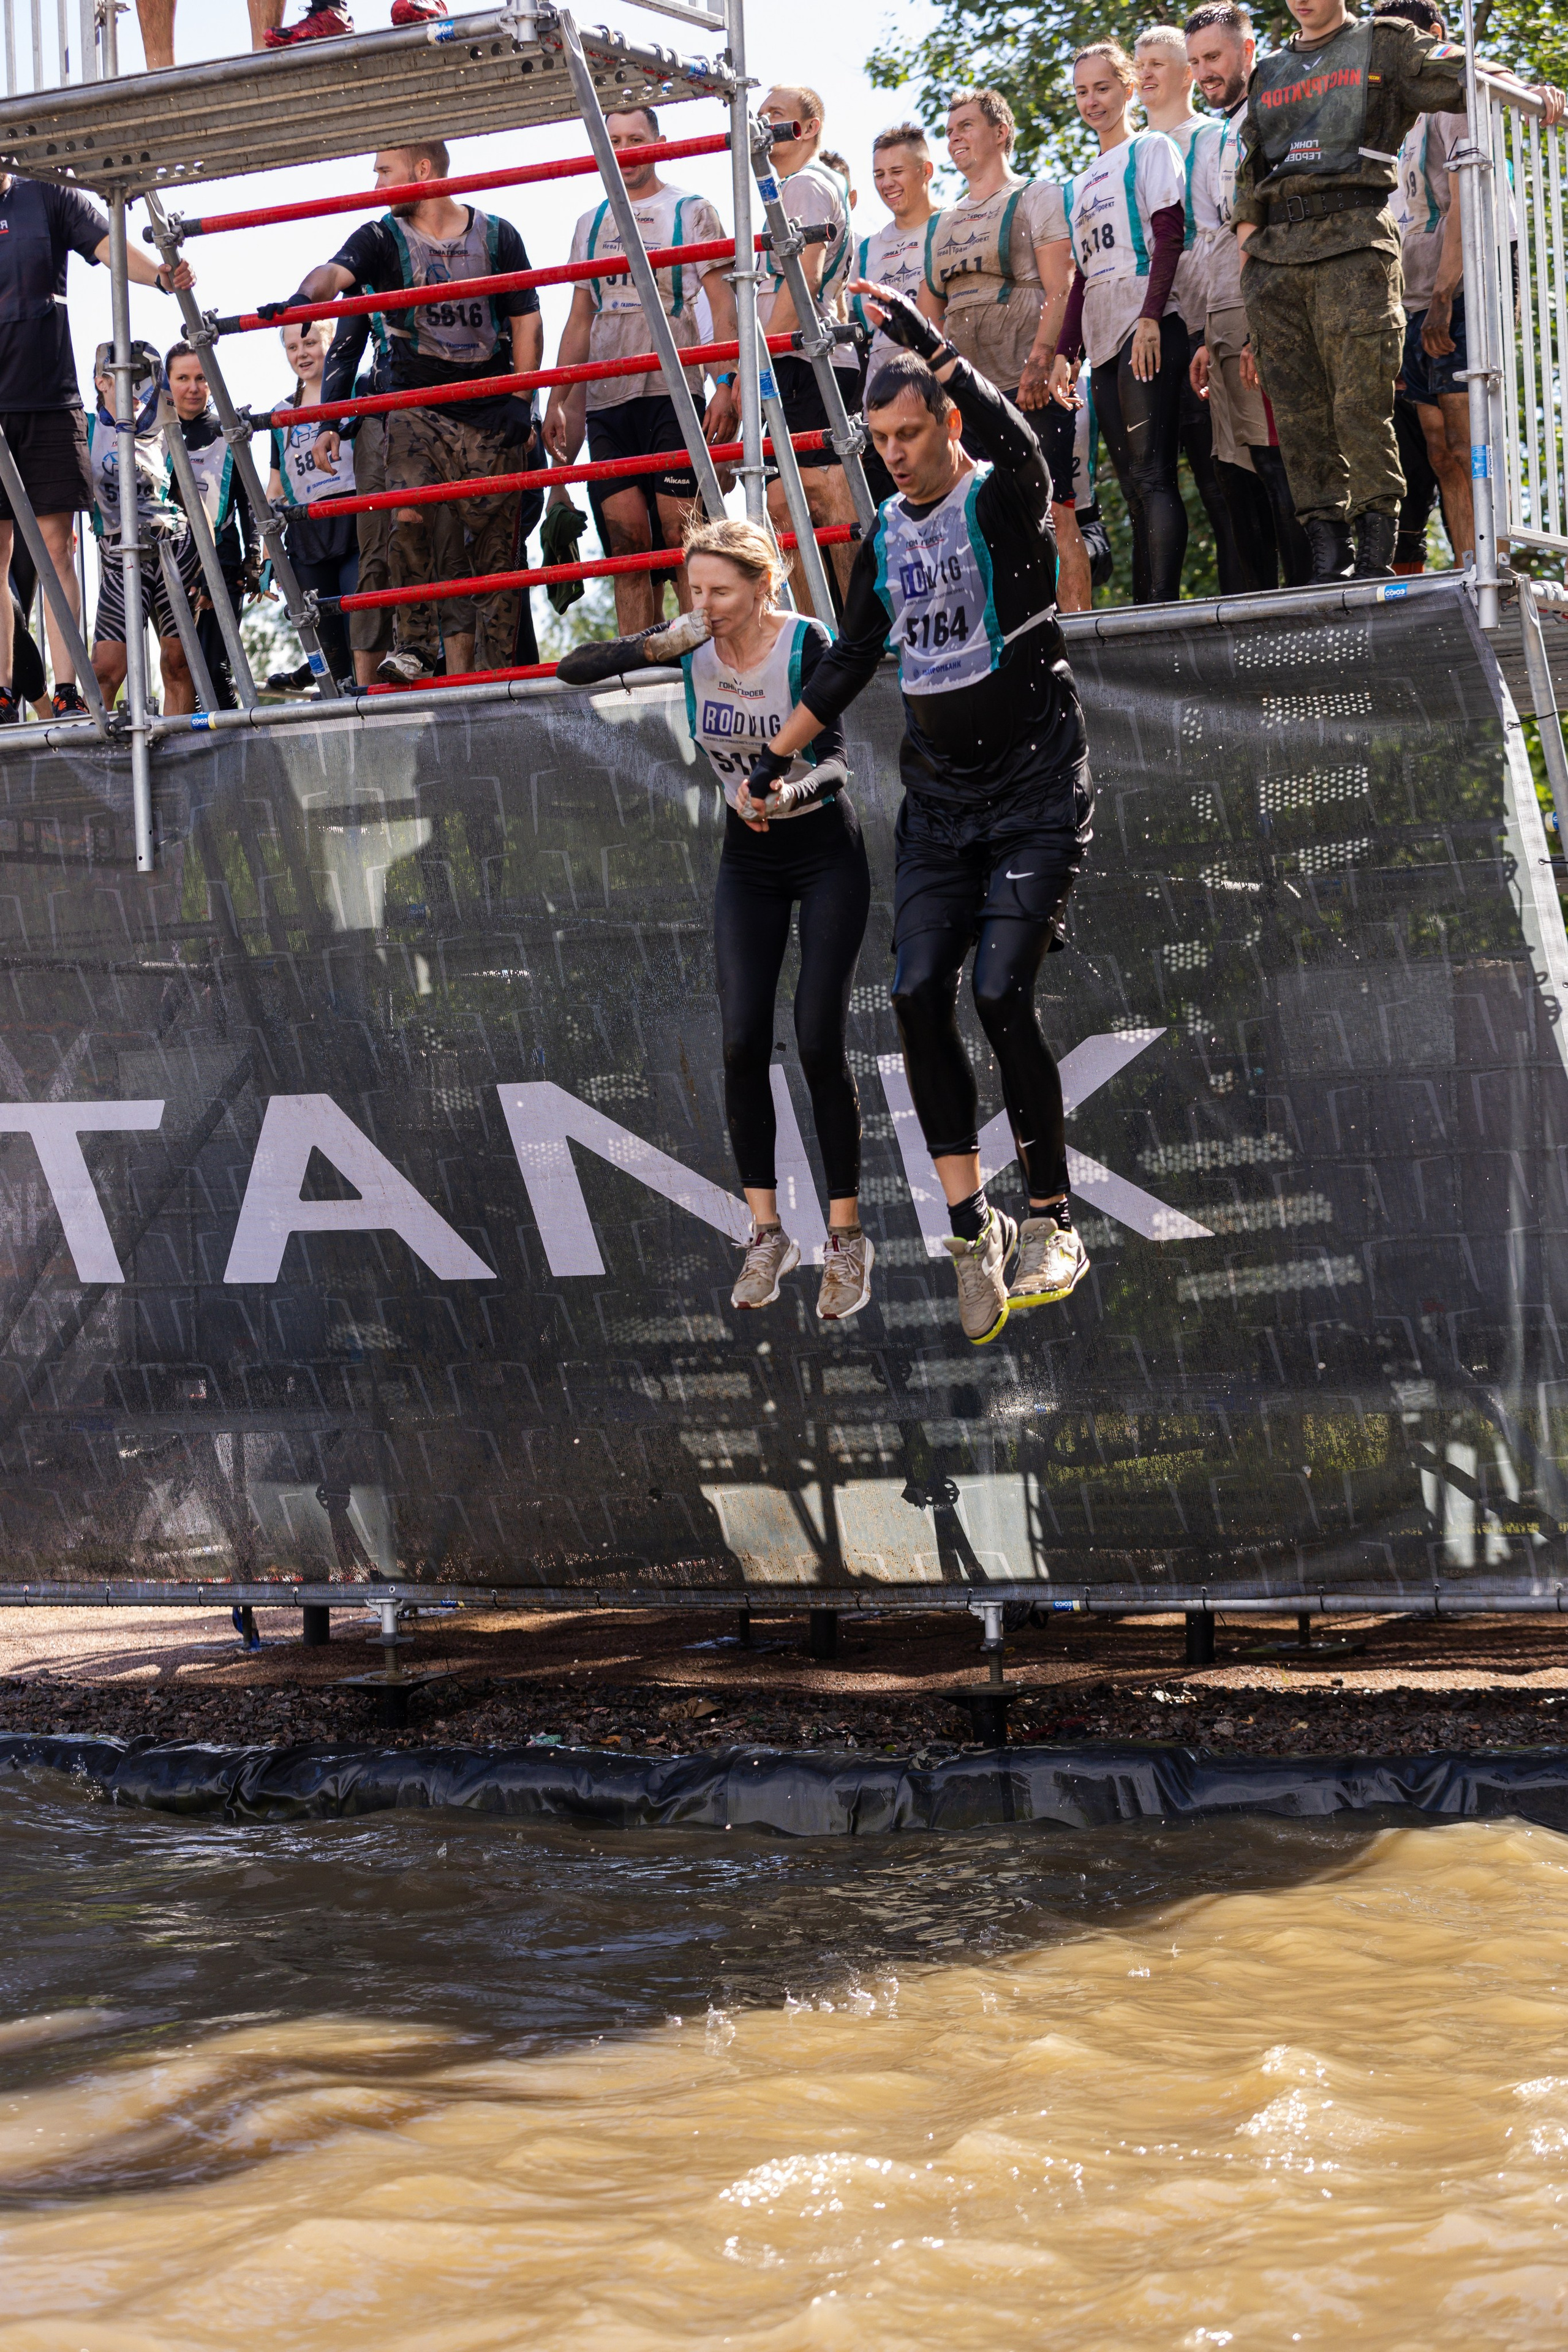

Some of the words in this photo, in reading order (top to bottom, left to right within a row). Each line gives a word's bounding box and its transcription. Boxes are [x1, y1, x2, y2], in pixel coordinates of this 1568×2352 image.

[900, 241, 918, 253] ГЕВ
[426, 303, 483, 328] 5816
[295, 450, 342, 477] 58
[906, 605, 969, 649] 5164
[737, 687, 764, 698] ГЕРОЕВ
[705, 706, 782, 738] RODVIG
[0, 1027, 1215, 1284] TANK
